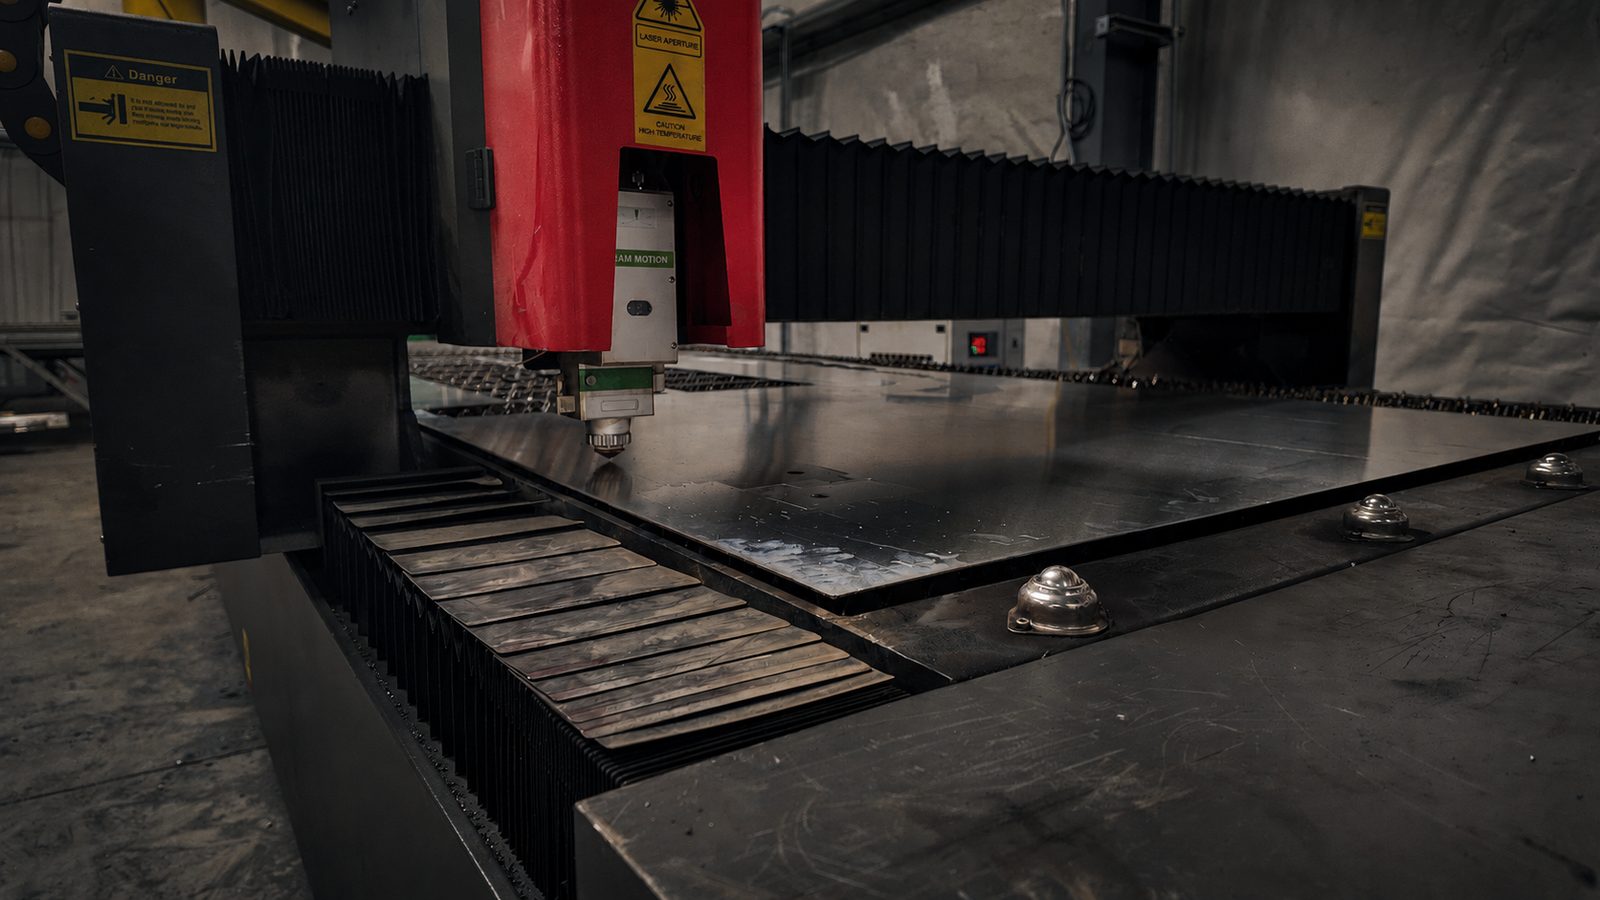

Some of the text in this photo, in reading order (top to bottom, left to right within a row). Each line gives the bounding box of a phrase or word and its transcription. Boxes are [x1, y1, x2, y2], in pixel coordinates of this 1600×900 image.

[639, 34, 699, 50] LASER APERTURE
[129, 69, 177, 85] Danger
[656, 121, 685, 131] CAUTION
[638, 127, 702, 141] HIGH TEMPERATURE
[634, 255, 668, 263] MOTION
